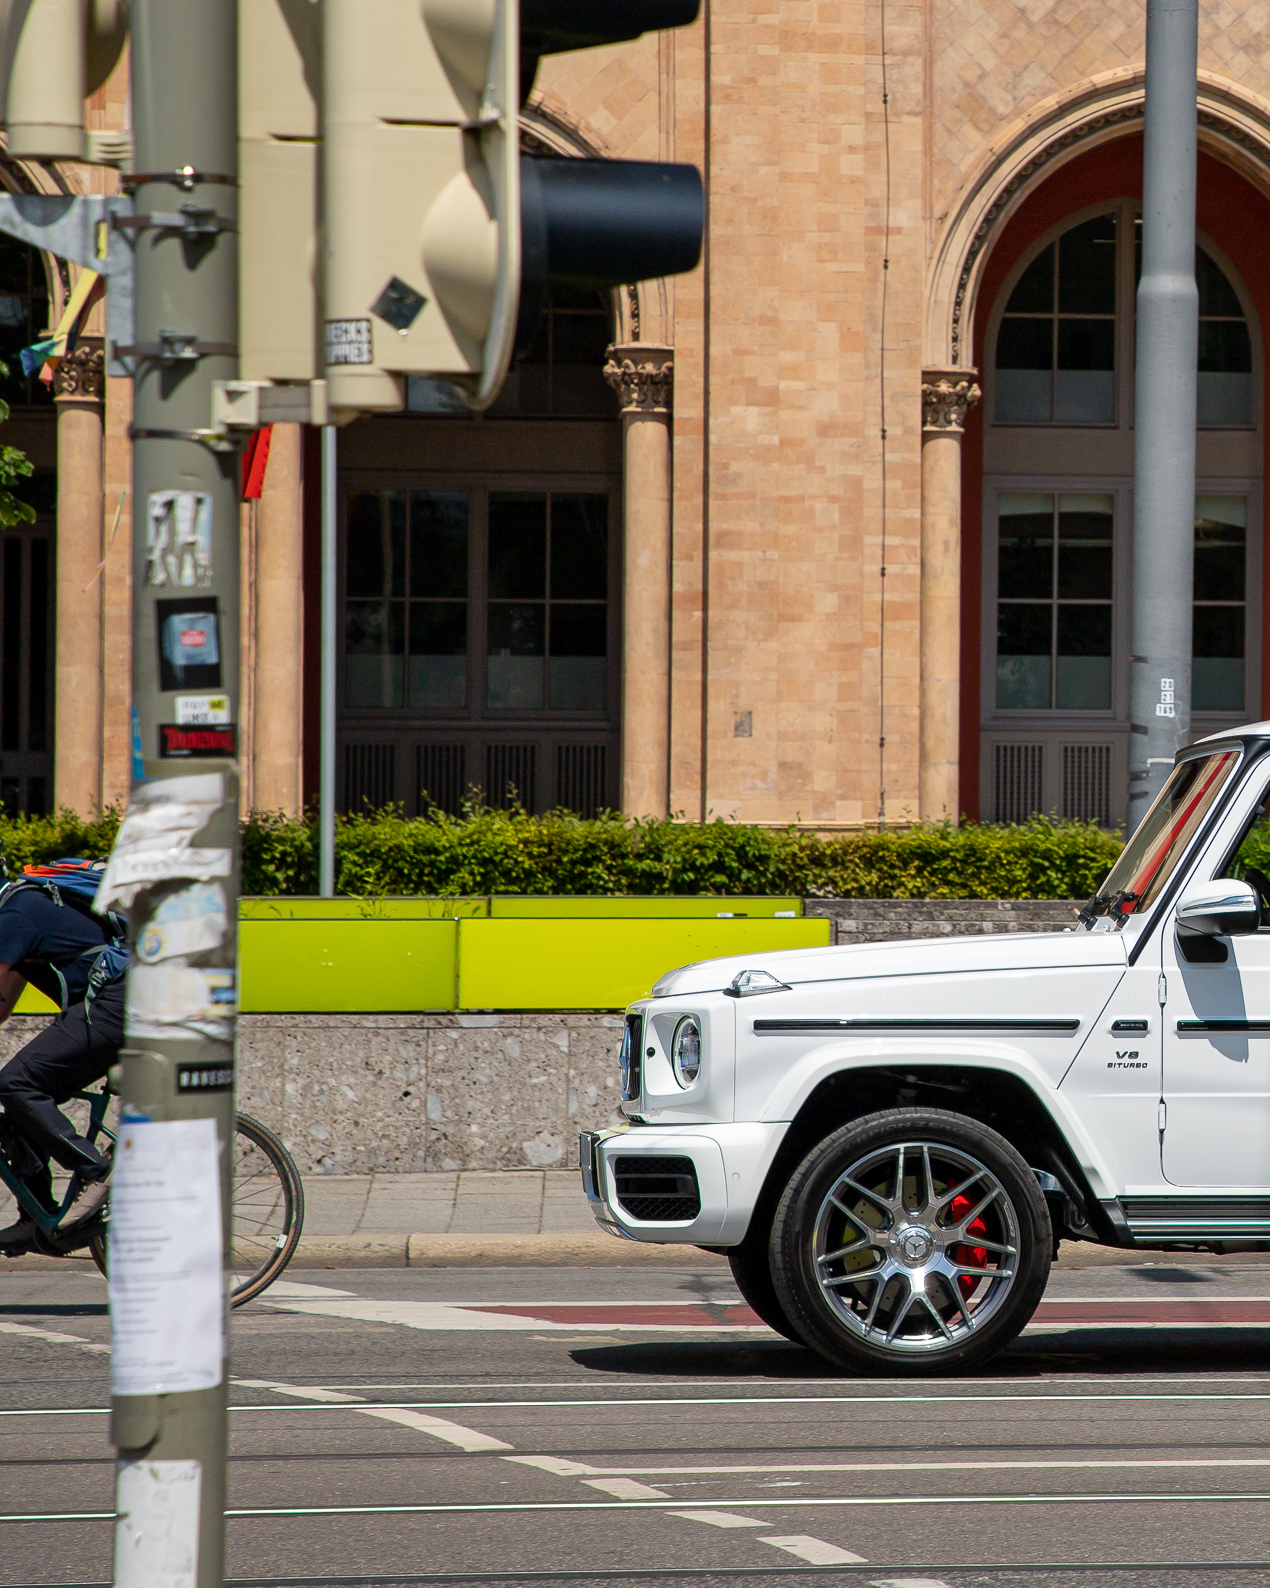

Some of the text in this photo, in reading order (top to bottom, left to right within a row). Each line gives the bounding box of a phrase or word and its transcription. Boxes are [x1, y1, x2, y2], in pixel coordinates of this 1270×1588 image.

[1162, 680, 1174, 690] 20
[1162, 693, 1174, 702] 21
[1115, 1050, 1139, 1060] V8
